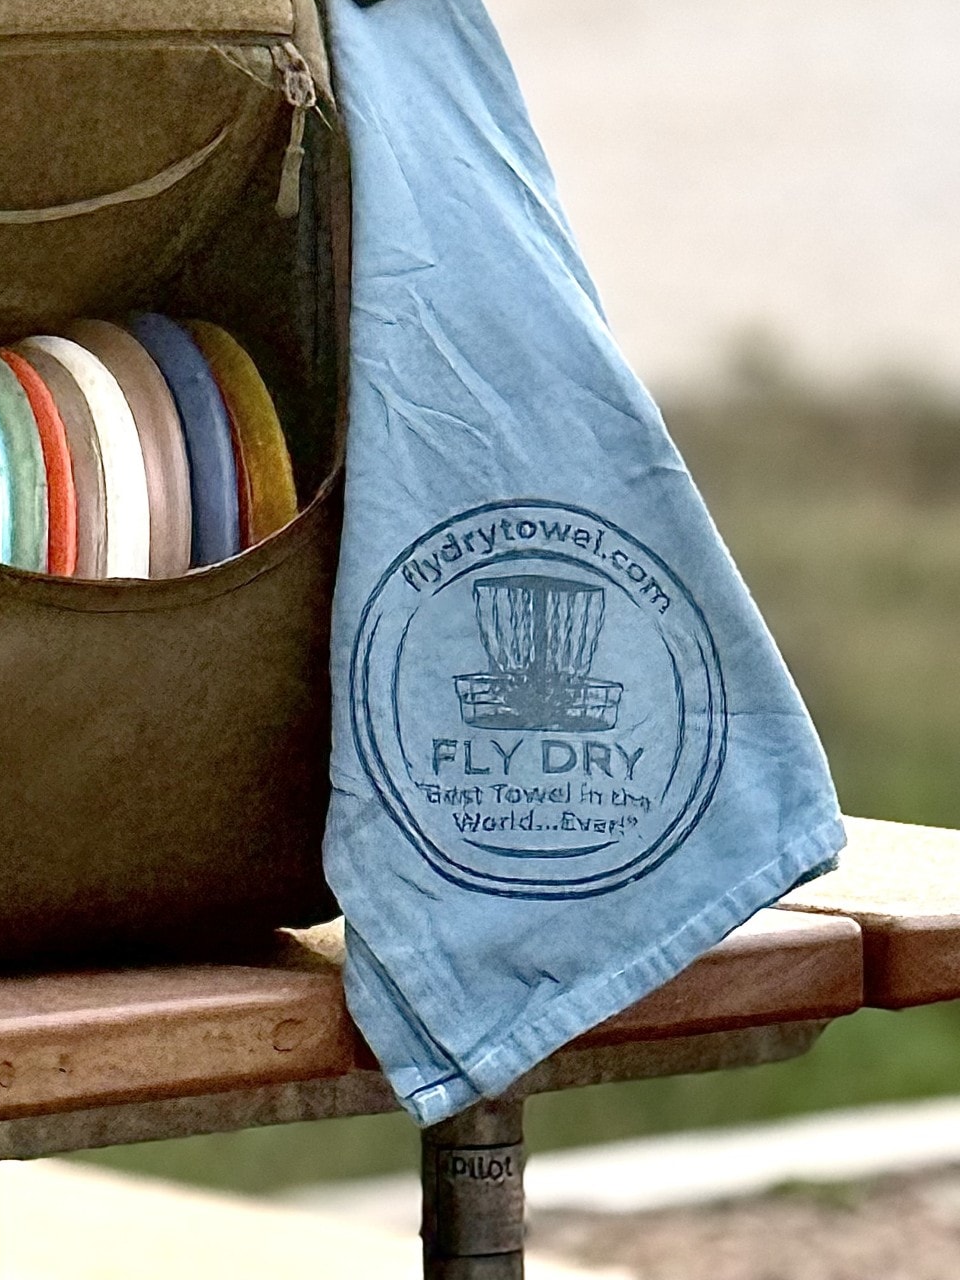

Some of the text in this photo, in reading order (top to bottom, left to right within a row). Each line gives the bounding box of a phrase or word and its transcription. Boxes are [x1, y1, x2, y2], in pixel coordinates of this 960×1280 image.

[401, 518, 671, 615] flydrytowel.com
[432, 738, 644, 780] FLY DRY
